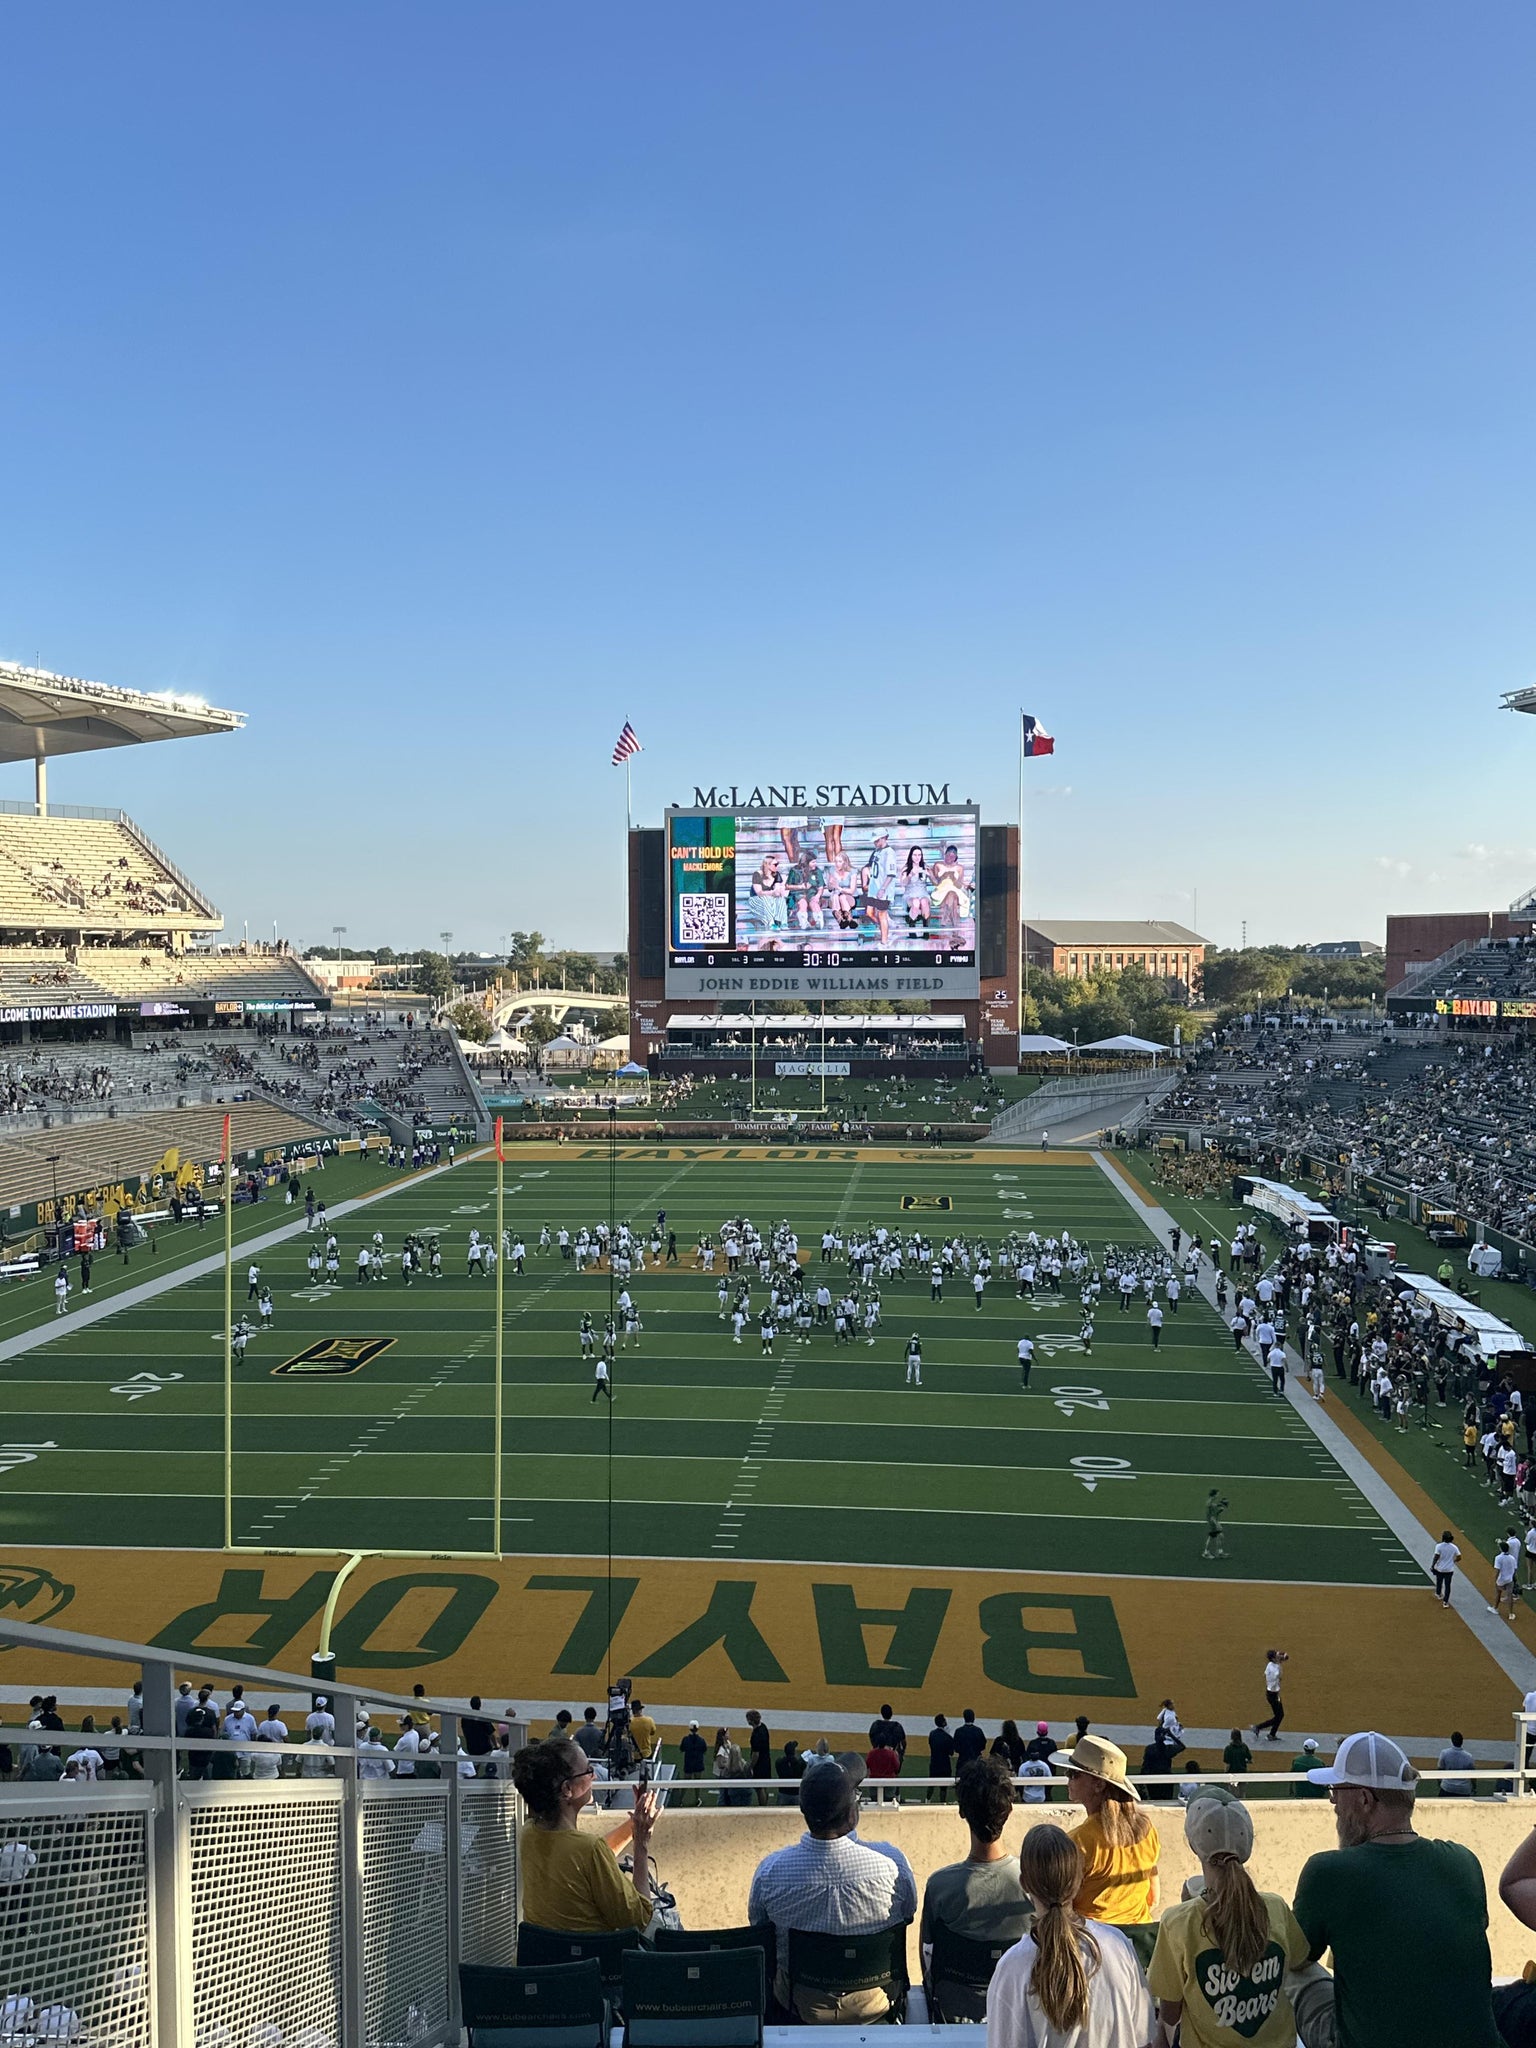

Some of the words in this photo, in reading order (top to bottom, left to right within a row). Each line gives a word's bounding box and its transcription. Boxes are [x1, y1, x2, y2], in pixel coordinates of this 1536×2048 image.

[693, 785, 807, 808] McLANE
[816, 783, 951, 806] STADIUM
[671, 847, 697, 859] CAN'T
[698, 847, 721, 858] HOLD
[722, 847, 735, 858] US
[683, 863, 723, 871] MACKLEMORE
[674, 956, 695, 964] BAYLOR
[743, 955, 749, 964] 3
[803, 953, 839, 966] 30:10
[699, 979, 743, 992] JOHN
[750, 979, 800, 990] EDDIE
[807, 979, 889, 990] WILLIAMS
[897, 979, 944, 990] FIELD
[995, 991, 1007, 999] 25
[30, 1007, 42, 1020] TO
[42, 1005, 76, 1020] MCLANE
[77, 1004, 117, 1018] STADIUM
[1453, 999, 1498, 1017] BAYLOR
[777, 1064, 848, 1073] MAGNOLIA
[734, 1123, 768, 1131] DIMMITT
[293, 1138, 342, 1156] NISSAN
[577, 1149, 859, 1159] BAYLOR
[1036, 1333, 1087, 1352] 30
[109, 1372, 185, 1394] 20
[1050, 1386, 1110, 1410] 20
[1069, 1456, 1137, 1481] 10
[145, 1569, 1138, 1698] BAYLOR
[1204, 1962, 1240, 1997] Sic
[635, 2000, 752, 2012] www.bubearchairs.com
[1213, 1989, 1279, 2028] Bears
